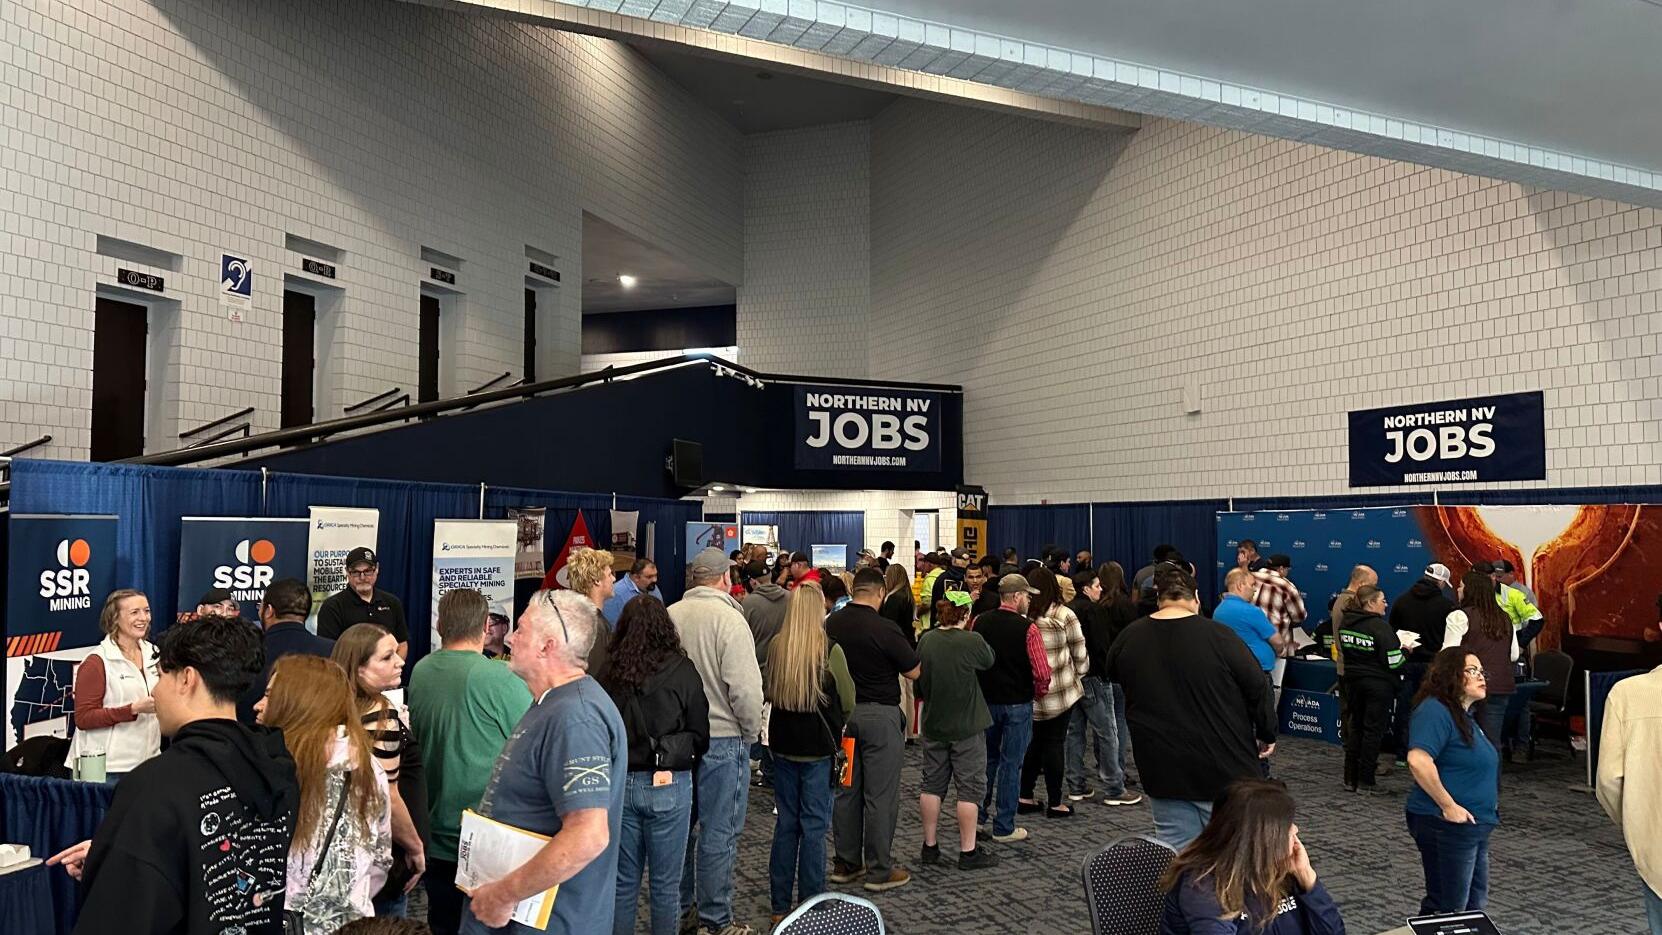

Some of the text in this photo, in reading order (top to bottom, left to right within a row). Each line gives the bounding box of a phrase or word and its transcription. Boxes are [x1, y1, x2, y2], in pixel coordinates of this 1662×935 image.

[127, 271, 157, 289] O-P
[806, 393, 930, 412] NORTHERN NV
[1384, 406, 1496, 429] NORTHERN NV
[806, 411, 930, 451] JOBS
[1384, 422, 1496, 463] JOBS
[833, 455, 906, 466] NORTHERNNVJOBS.COM
[1404, 470, 1477, 482] NORTHERNNVJOBS.COM
[958, 493, 983, 511] CAT
[314, 550, 350, 558] OUR PURPO
[313, 559, 324, 567] TO
[40, 568, 90, 598] SSR
[213, 565, 274, 589] SSR
[313, 576, 327, 584] THE
[313, 584, 347, 592] RESOURCE
[230, 590, 265, 602] MININ
[50, 596, 90, 611] MINING
[1292, 711, 1318, 723] Process
[1288, 720, 1323, 734] Operations
[582, 777, 599, 785] GS
